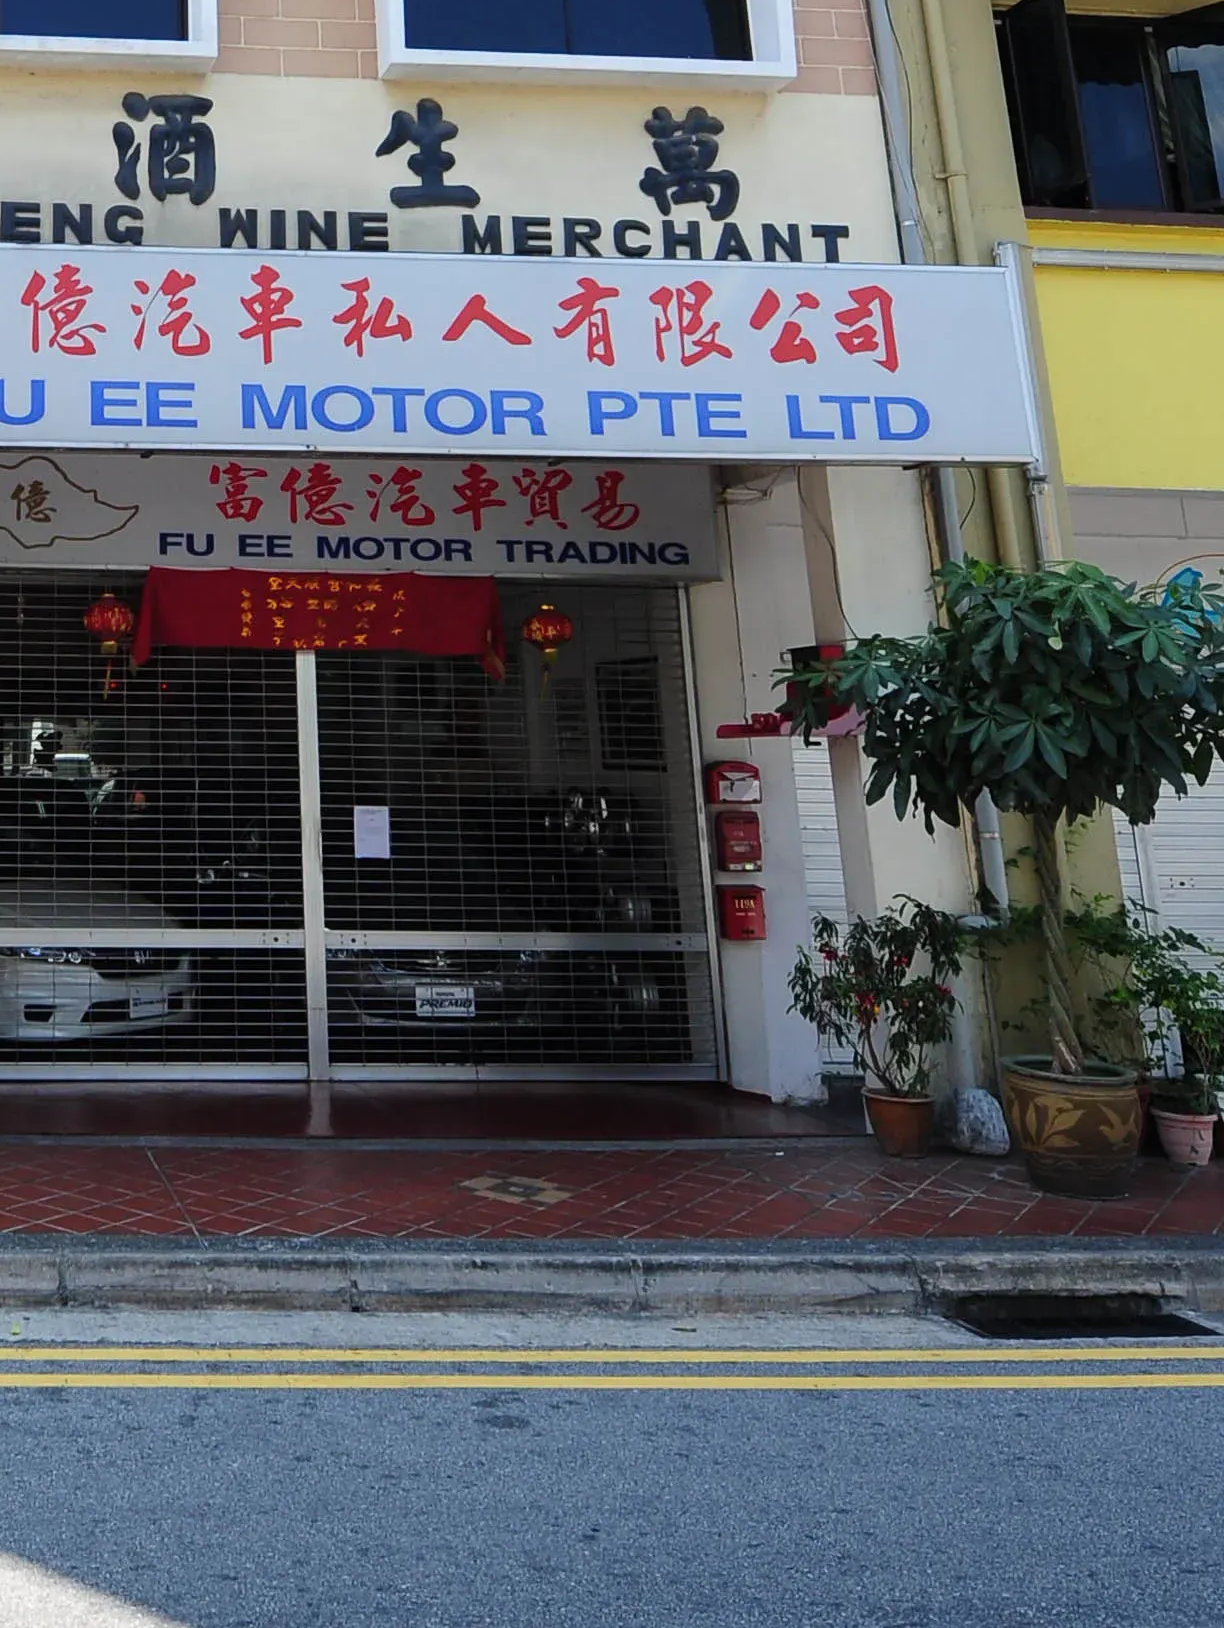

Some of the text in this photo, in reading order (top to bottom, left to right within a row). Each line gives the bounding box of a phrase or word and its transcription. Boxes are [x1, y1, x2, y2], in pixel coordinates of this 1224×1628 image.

[219, 207, 389, 252] WINE
[461, 213, 850, 264] MERCHANT
[89, 379, 199, 429] EE
[240, 382, 548, 437] MOTOR
[586, 389, 749, 440] PTE
[784, 393, 931, 443] LTD
[10, 479, 58, 523] 億
[208, 460, 642, 532] 富億汽車貿易
[158, 532, 690, 566] FU EE MOTOR TRADING
